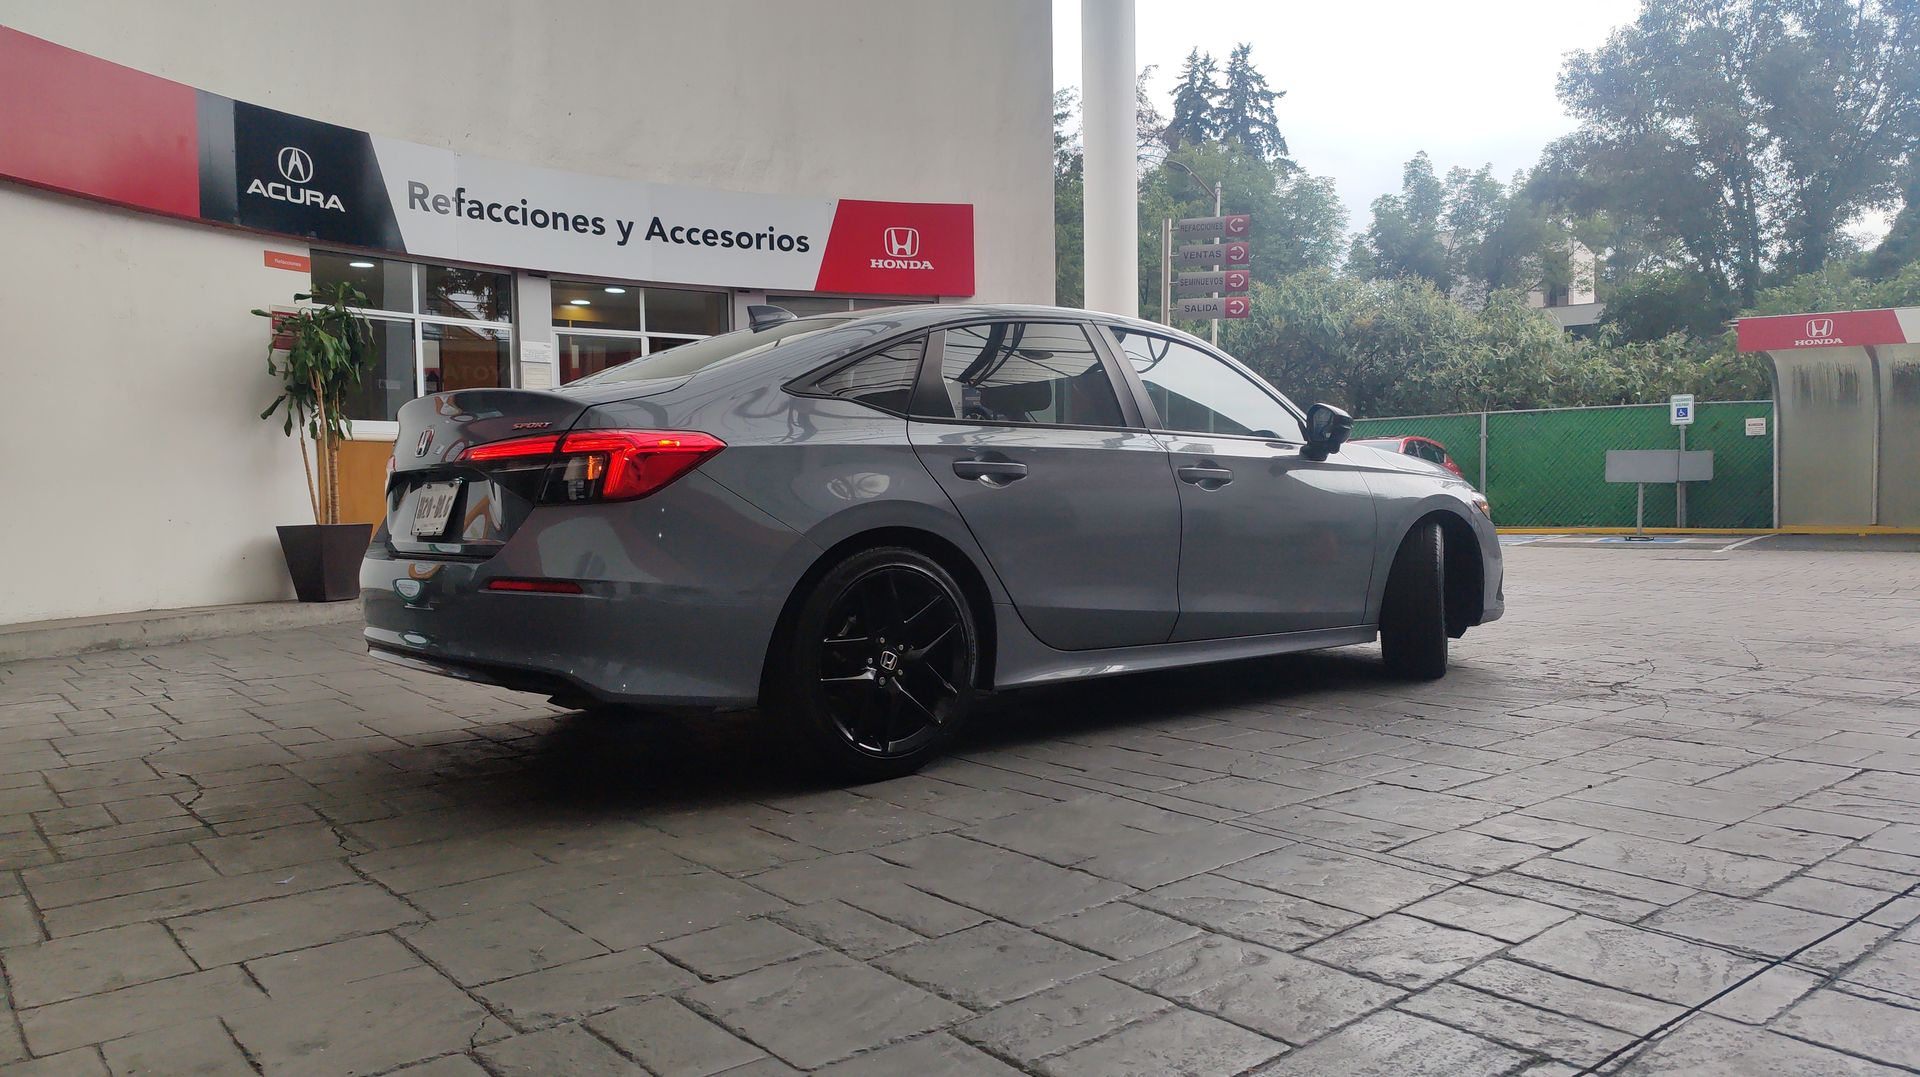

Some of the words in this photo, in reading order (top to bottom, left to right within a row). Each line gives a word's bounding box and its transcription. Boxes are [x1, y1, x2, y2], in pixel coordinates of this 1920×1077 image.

[247, 178, 346, 213] ACURA
[407, 180, 606, 236] Refacciones
[616, 218, 635, 246] y
[645, 216, 810, 253] Accesorios
[1180, 223, 1223, 233] REFACCIONES
[1183, 250, 1222, 260] VENTAS
[870, 258, 935, 270] HONDA
[1180, 277, 1224, 287] SEMINUEVOS
[1184, 303, 1219, 313] SALIDA
[1794, 338, 1844, 346] HONDA
[512, 421, 552, 430] SPORT
